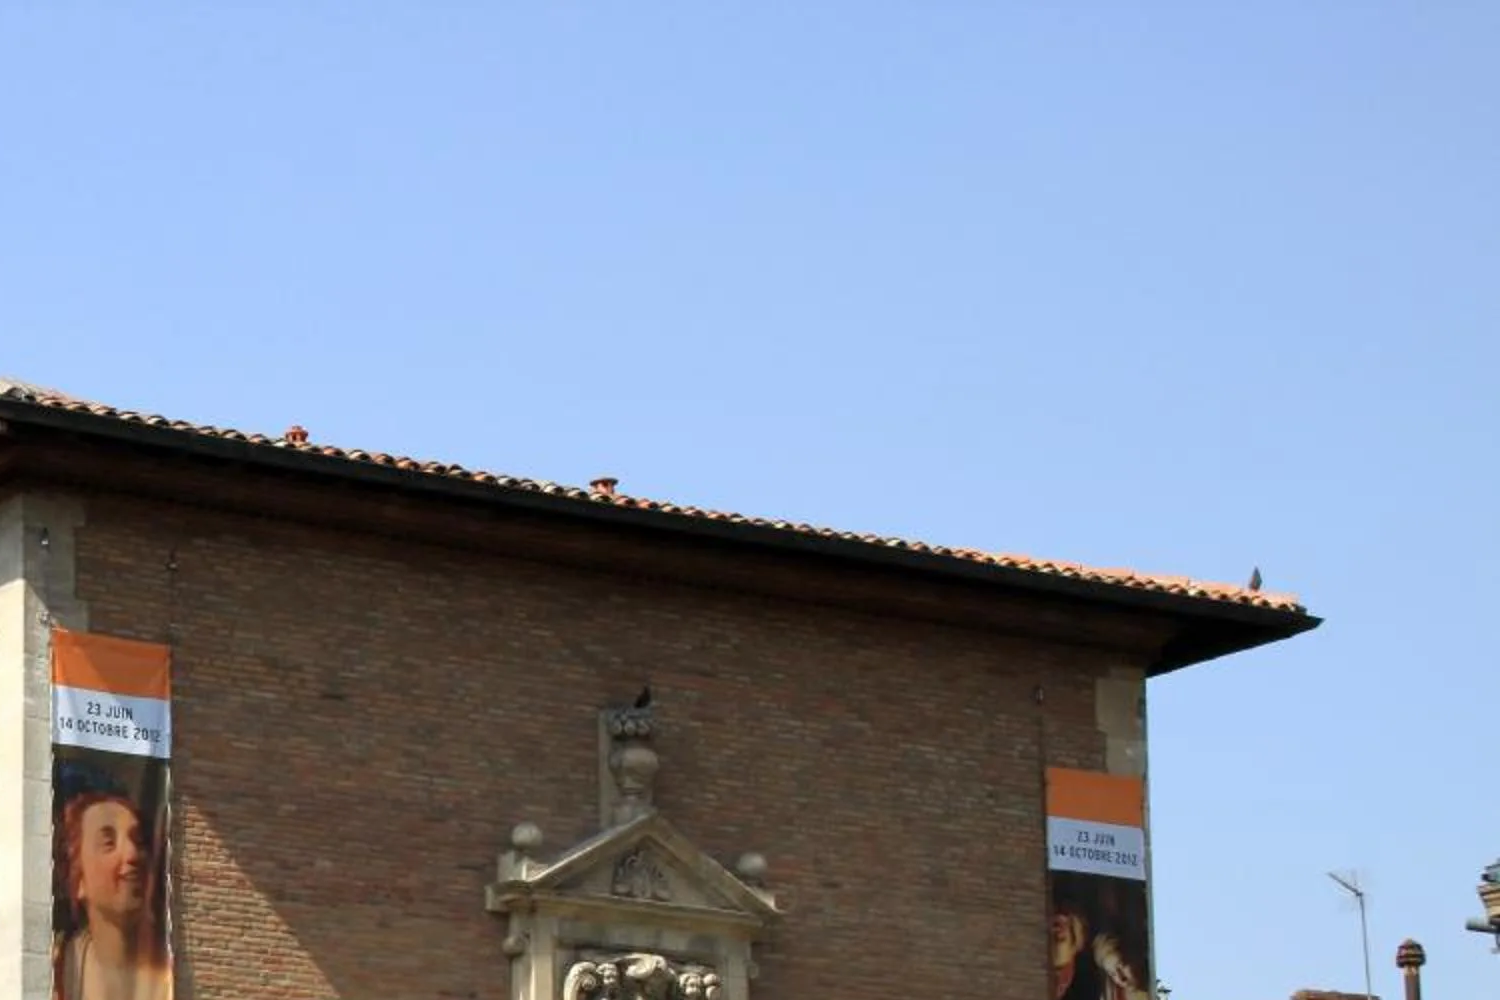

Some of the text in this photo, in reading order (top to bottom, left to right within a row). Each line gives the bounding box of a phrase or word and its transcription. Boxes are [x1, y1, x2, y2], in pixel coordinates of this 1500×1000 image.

[86, 701, 133, 721] 23 JUIN
[59, 717, 73, 730] 14
[77, 719, 129, 739] OCTOBRE
[1094, 833, 1115, 847] JUIN
[1069, 845, 1114, 863] OCTOBRE
